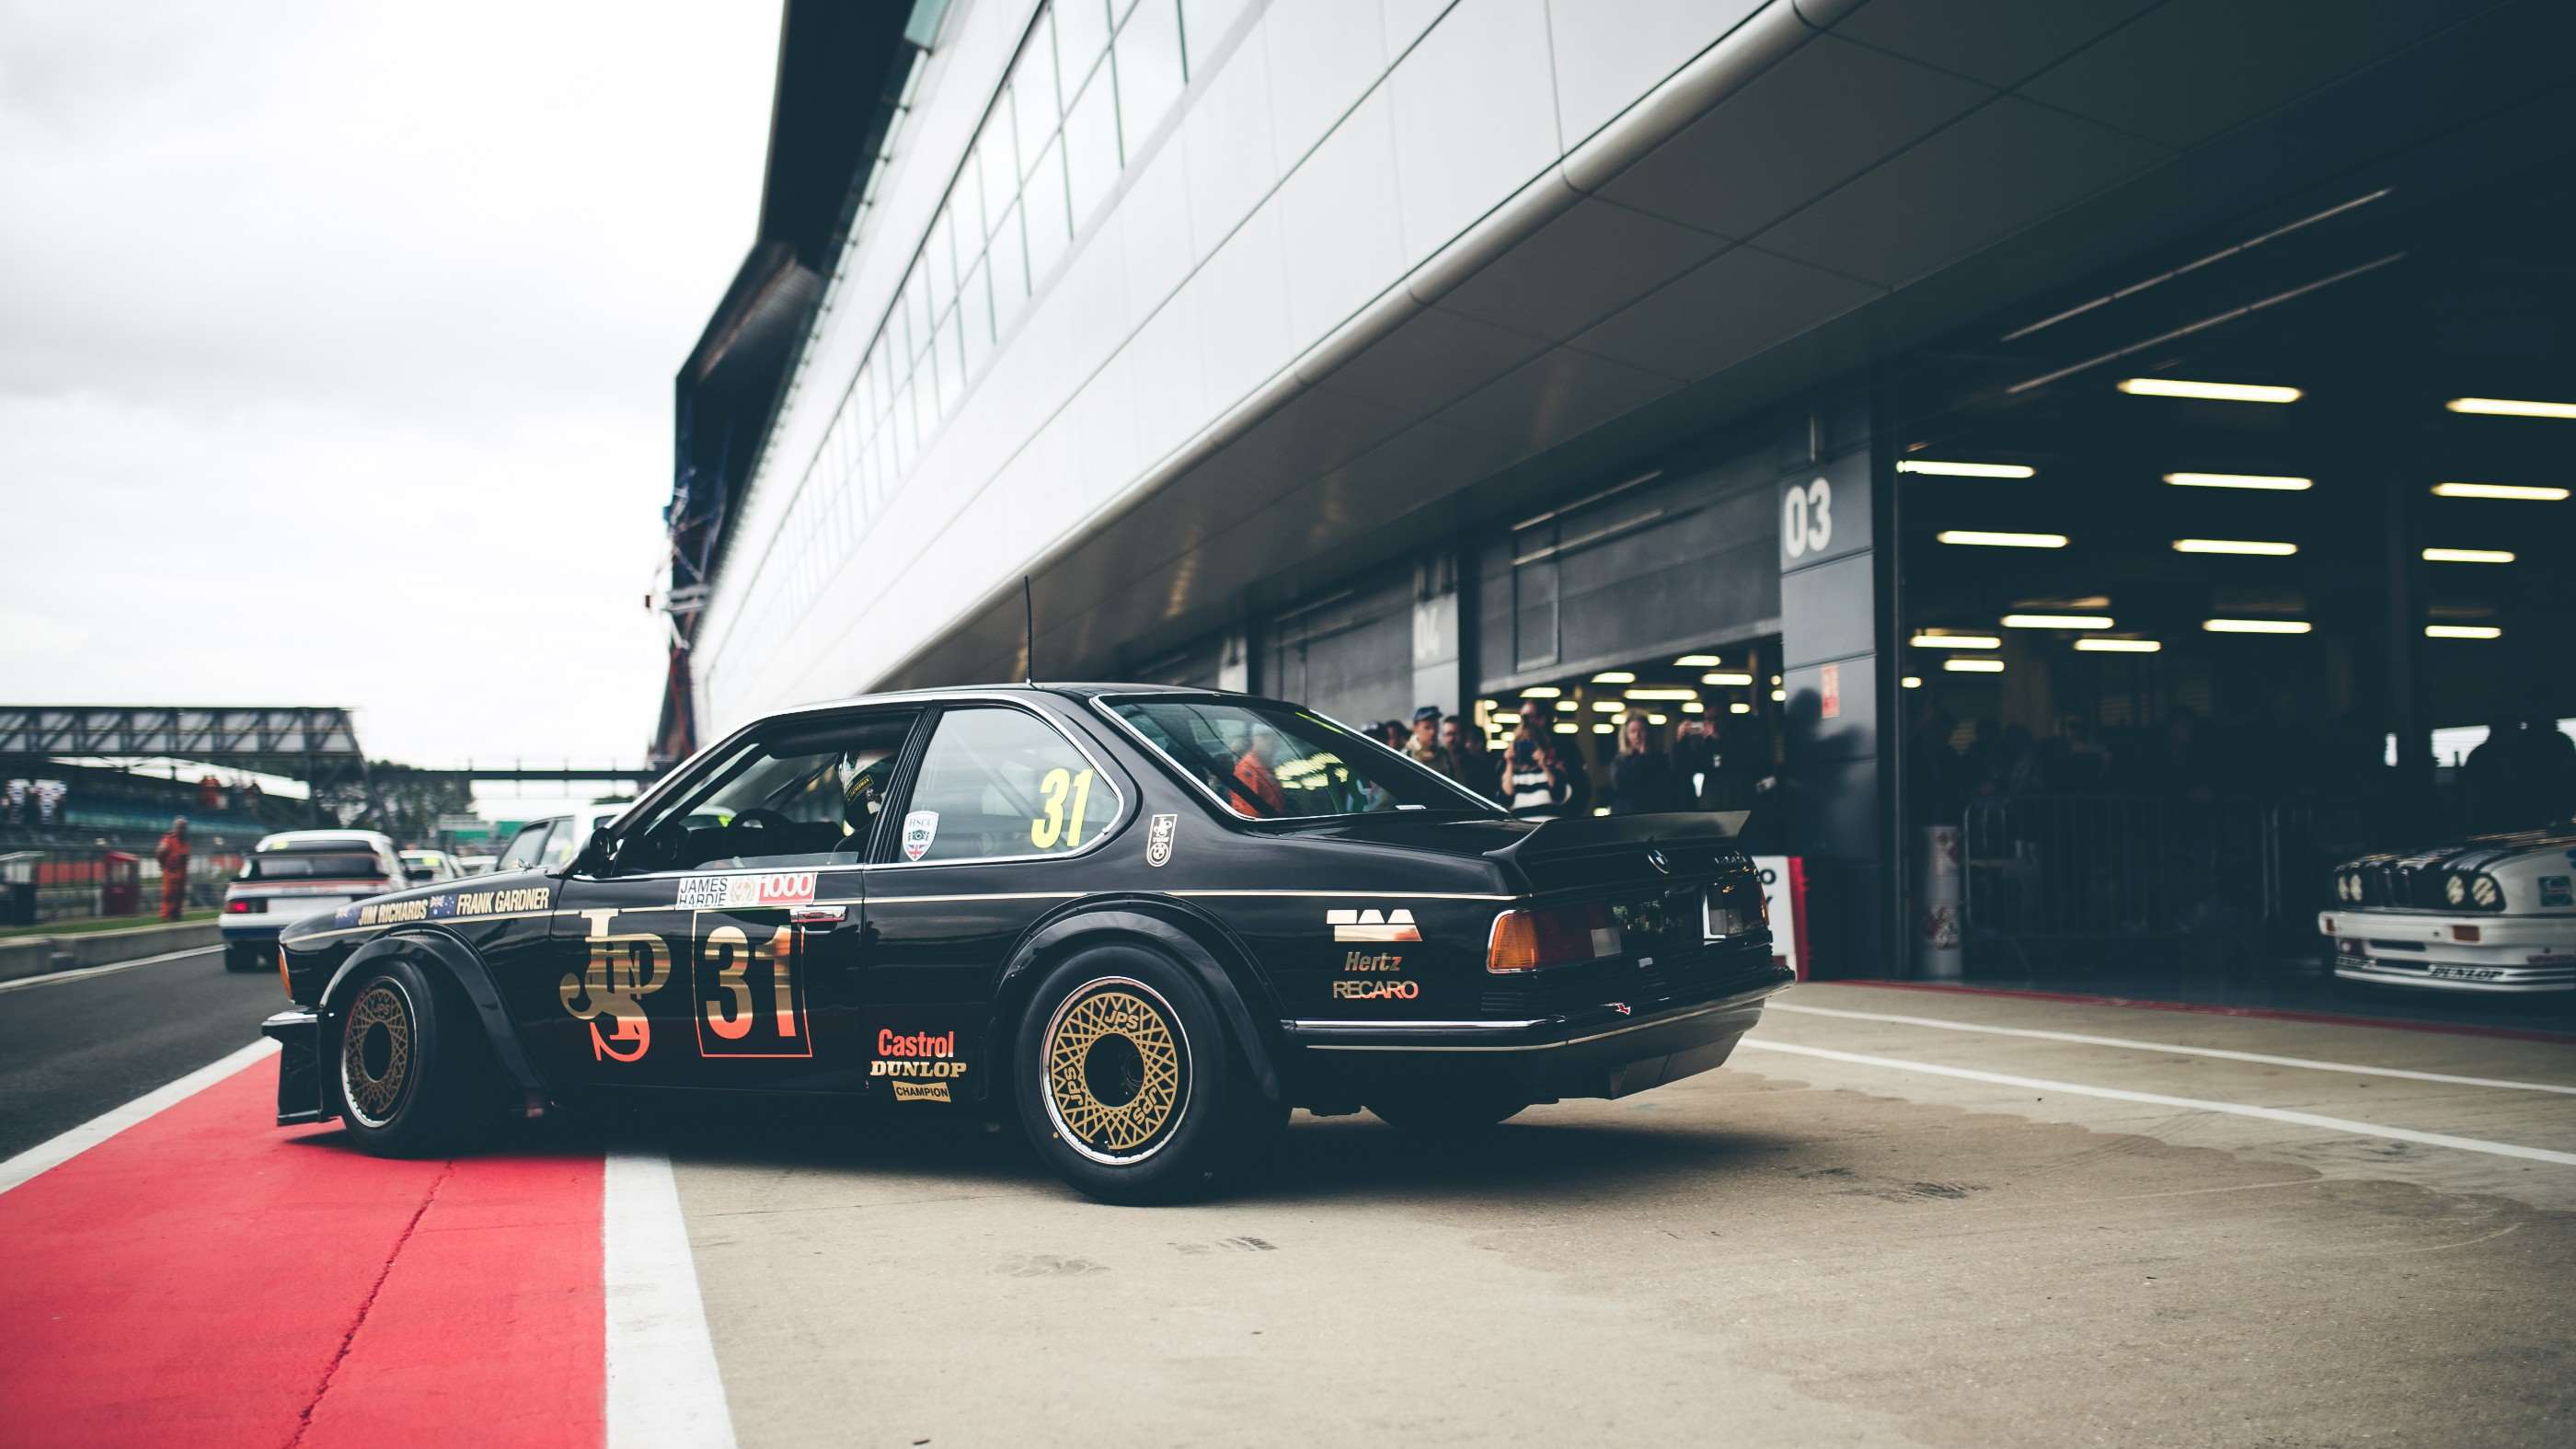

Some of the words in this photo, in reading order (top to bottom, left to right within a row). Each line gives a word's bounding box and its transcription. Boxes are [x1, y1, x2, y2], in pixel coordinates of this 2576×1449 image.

[1784, 477, 1832, 558] 03
[1031, 767, 1095, 848] 31
[681, 877, 728, 893] JAMES
[358, 906, 376, 926] JIM
[378, 899, 429, 924] RICHARDS
[456, 891, 495, 915] FRANK
[495, 888, 550, 913] GARDNER
[678, 892, 726, 906] HARDIE
[1344, 951, 1402, 972] Hertz
[705, 926, 797, 1040] 31
[1332, 980, 1420, 999] RECARO
[1104, 1010, 1139, 1029] JPS
[879, 1029, 954, 1058] Castrol
[869, 1061, 967, 1077] DUNLOP
[896, 1087, 949, 1098] CHAMPION
[1064, 1066, 1085, 1106] JPS
[1133, 1087, 1157, 1124] JPS
